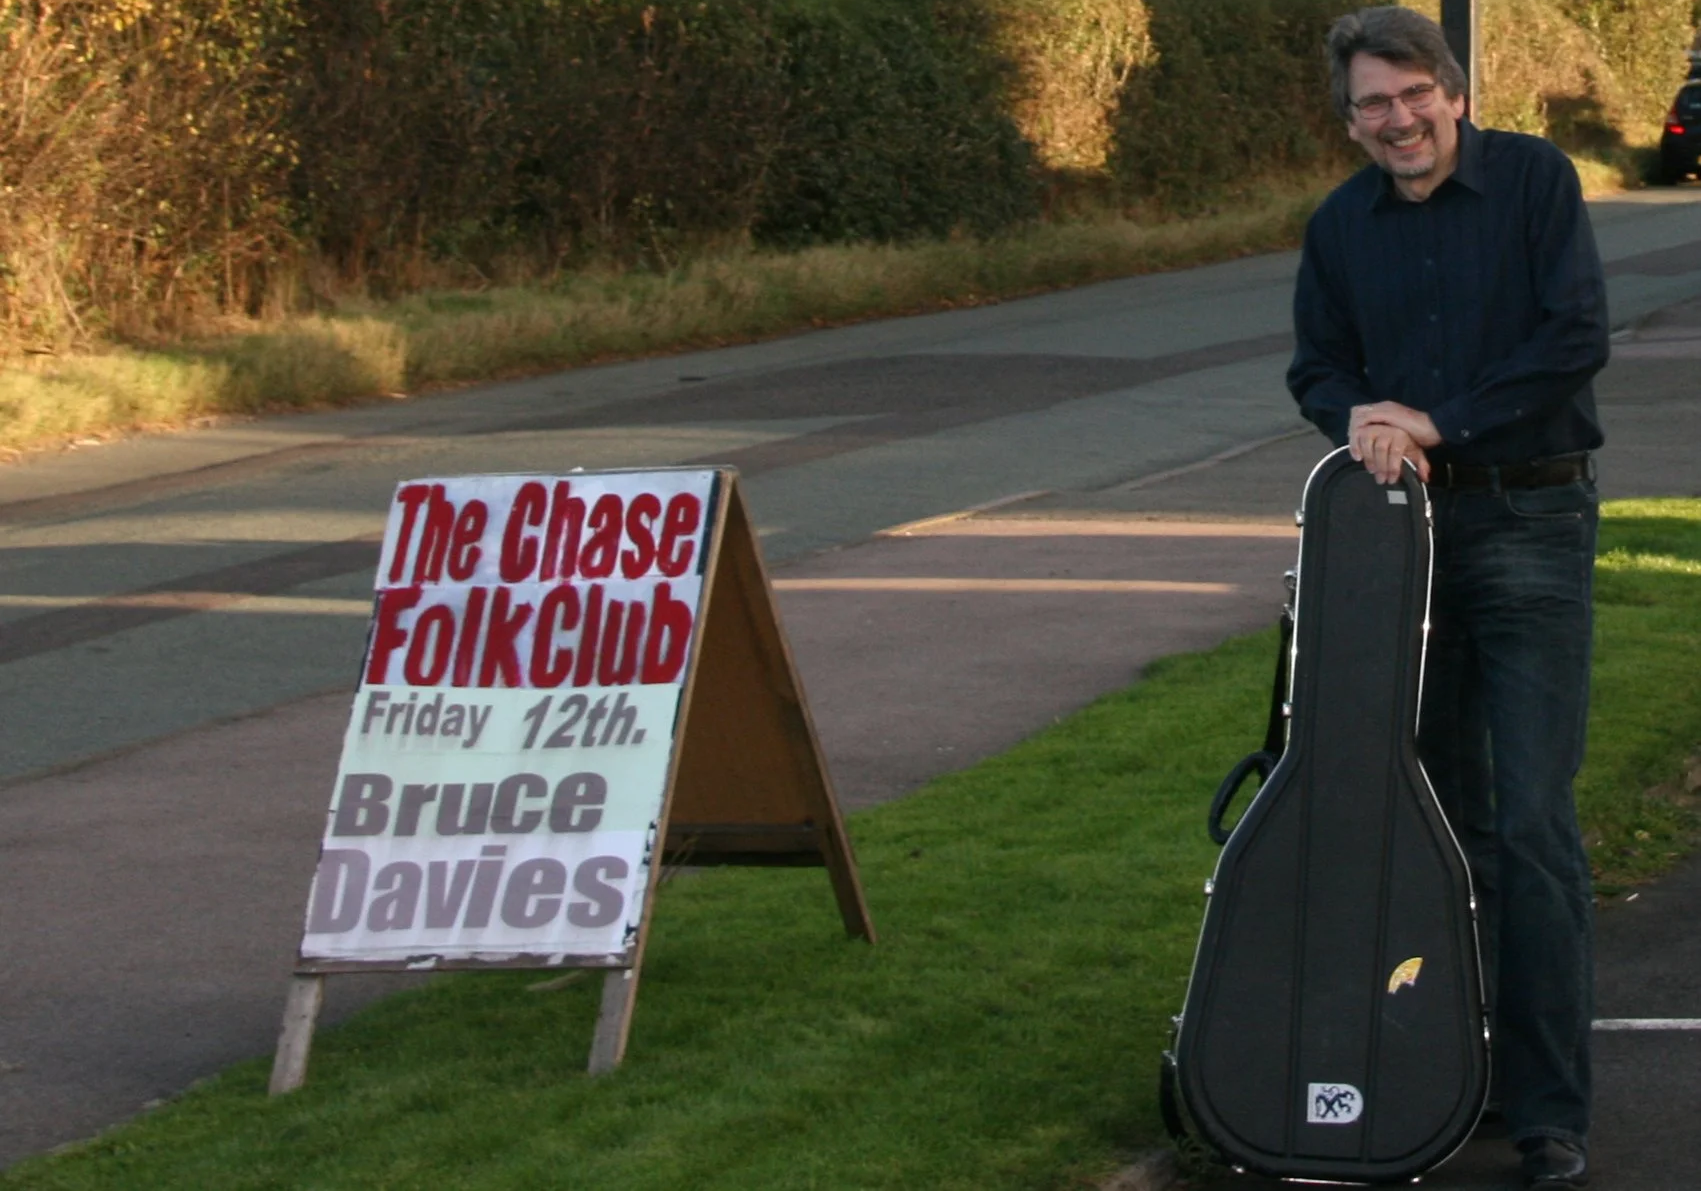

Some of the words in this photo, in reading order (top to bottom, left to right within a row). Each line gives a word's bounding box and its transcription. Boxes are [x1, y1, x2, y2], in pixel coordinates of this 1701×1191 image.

[387, 483, 489, 585] The
[499, 480, 701, 584] Chase
[360, 691, 493, 748] Friday
[522, 692, 648, 750] 12th.
[332, 772, 608, 837] Bruce
[309, 845, 629, 934] Davies
